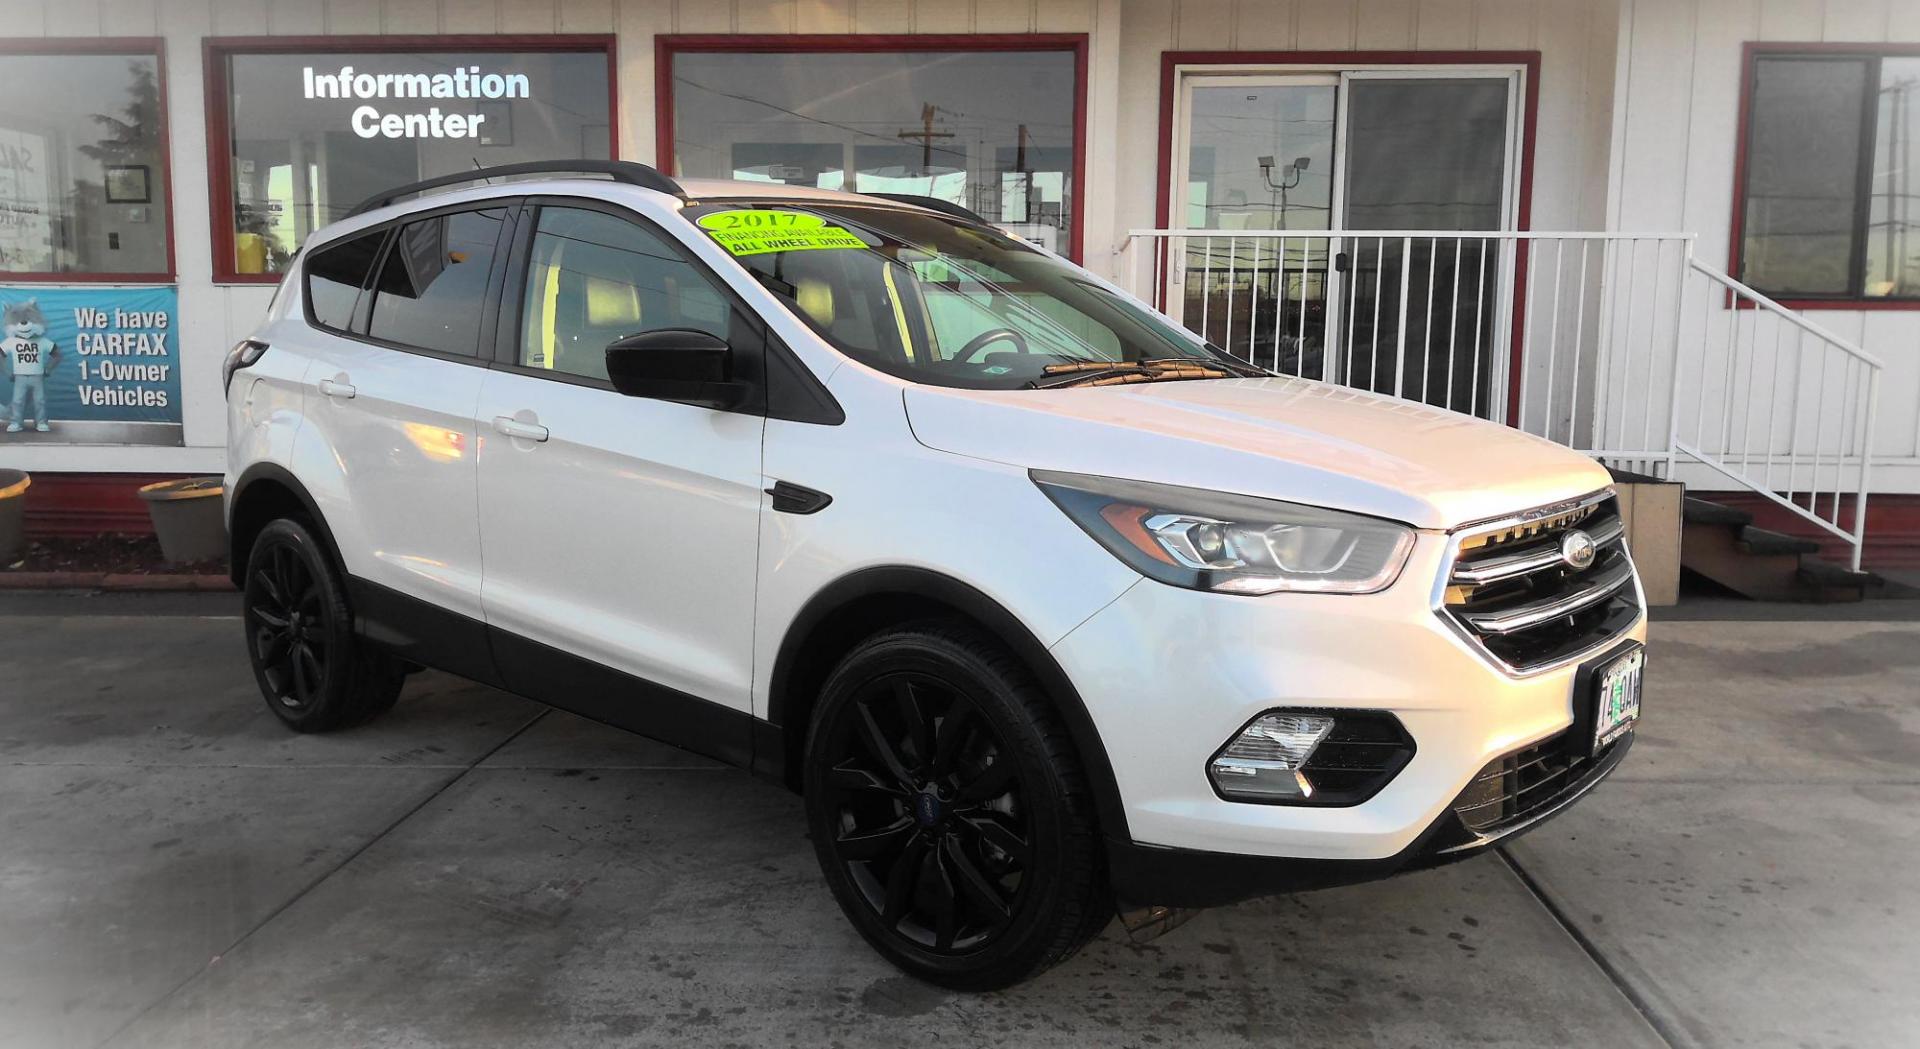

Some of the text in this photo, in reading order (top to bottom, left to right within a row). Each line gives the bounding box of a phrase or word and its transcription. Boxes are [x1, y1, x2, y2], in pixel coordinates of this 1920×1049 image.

[303, 66, 530, 99] Information
[351, 105, 485, 139] Center
[722, 214, 798, 229] 2017
[715, 227, 848, 243] FINANCING AVAILABLE
[732, 237, 861, 253] ALL WHEEL DRIVE
[74, 307, 168, 329] We have
[15, 343, 39, 353] CAR
[76, 333, 168, 356] CARFAX
[18, 353, 39, 364] FOX
[78, 359, 170, 381] 1-Owner
[78, 385, 168, 407] Vehicles
